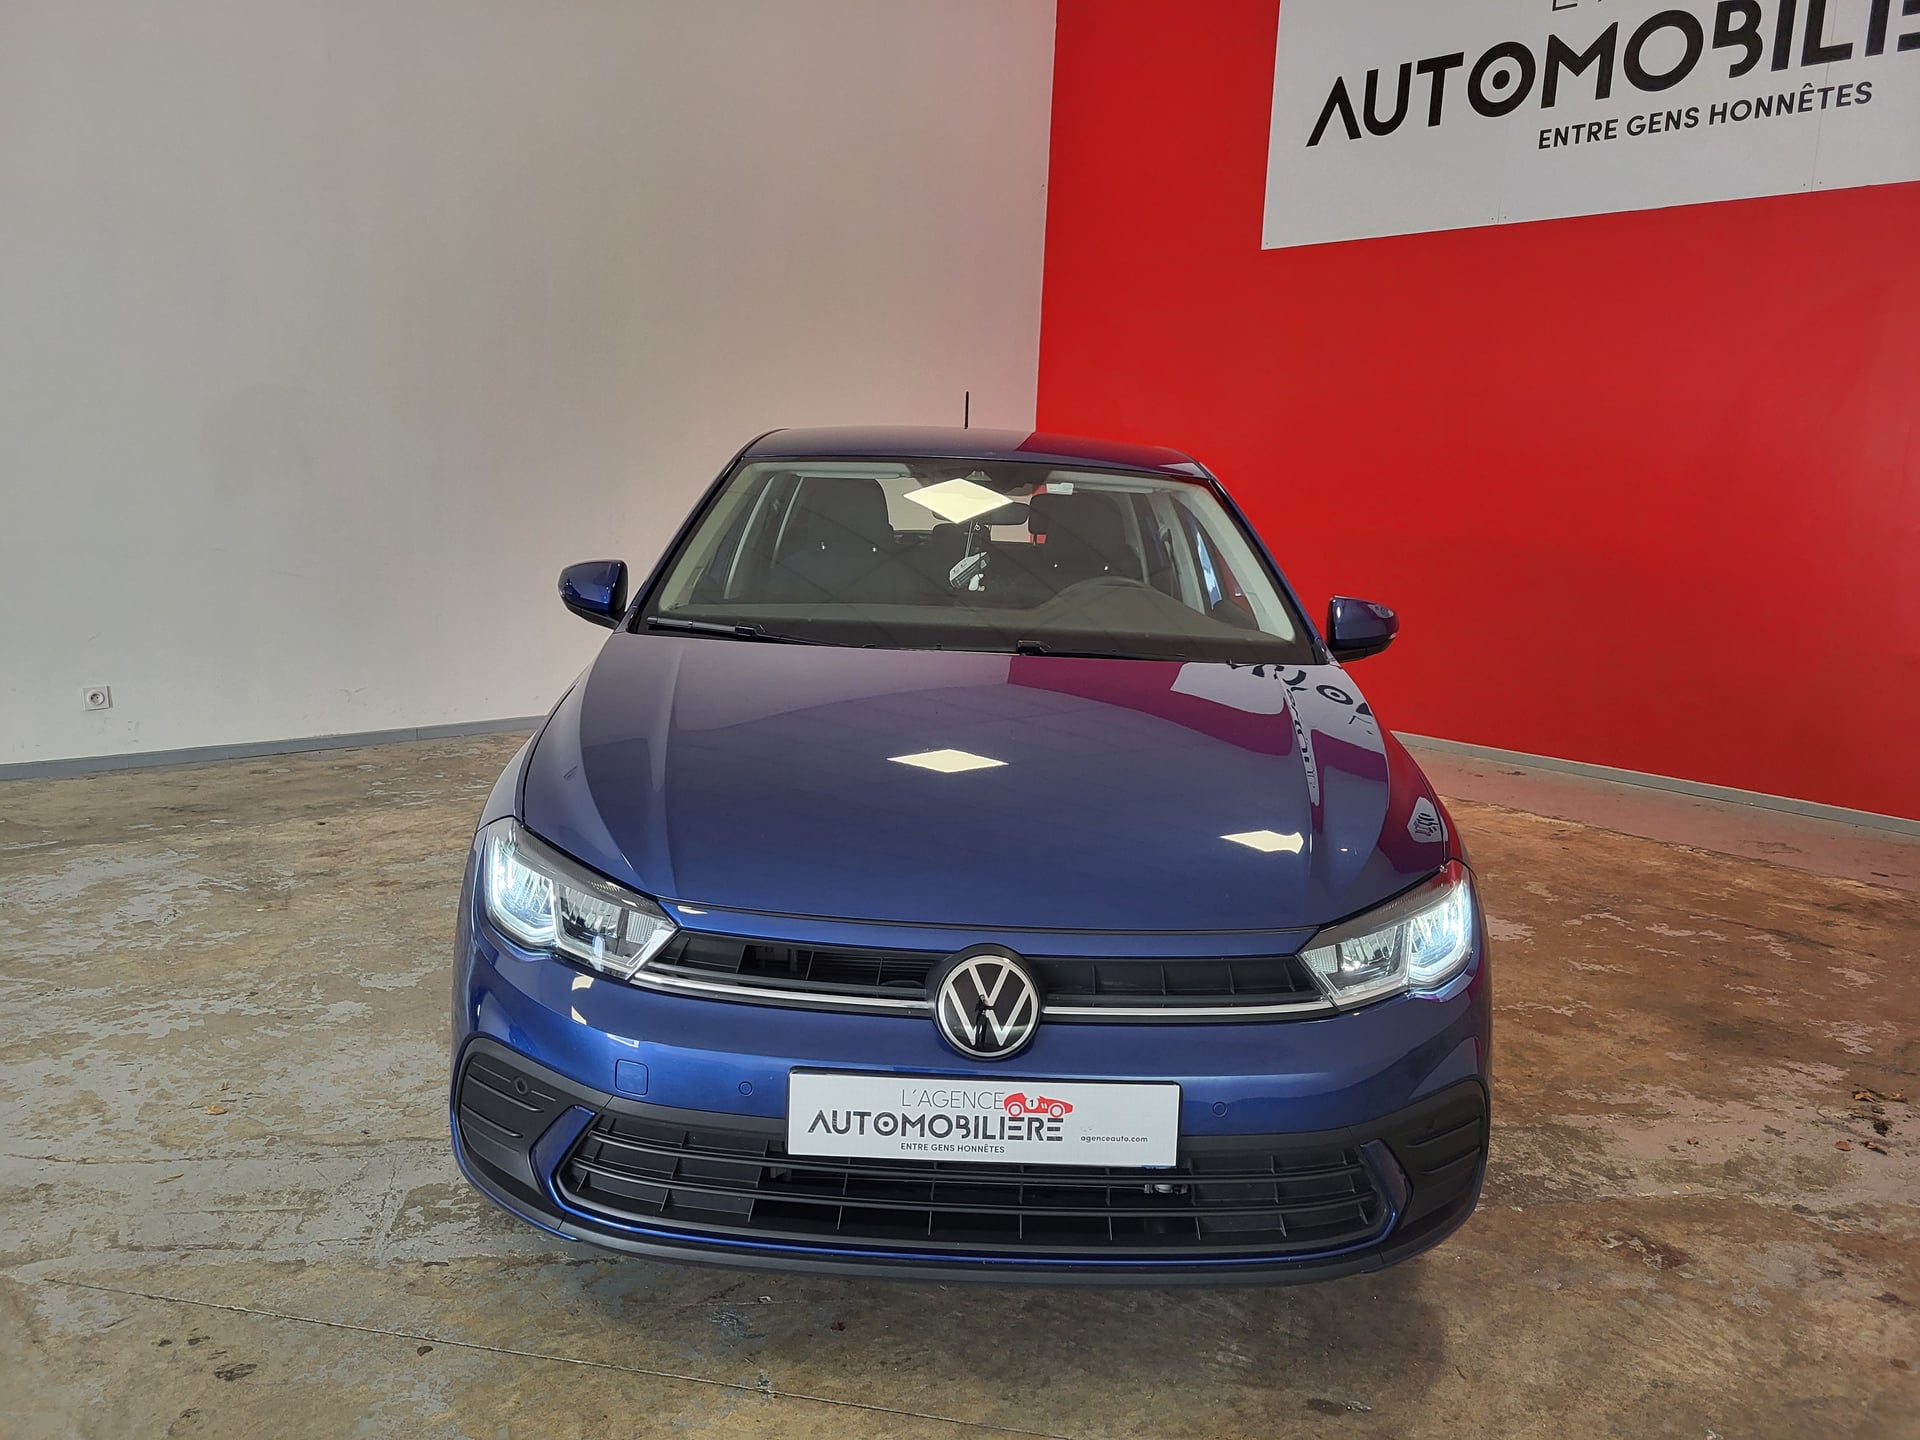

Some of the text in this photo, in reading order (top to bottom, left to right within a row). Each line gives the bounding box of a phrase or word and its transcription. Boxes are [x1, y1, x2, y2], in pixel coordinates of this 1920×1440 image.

[1538, 81, 1874, 149] ENTRE GENS HONNÊTES
[901, 1089, 1005, 1110] L'AGENCE
[1080, 1135, 1149, 1144] agenceauto.com
[900, 1142, 1005, 1154] ENTRE GENS HONNÊTES
